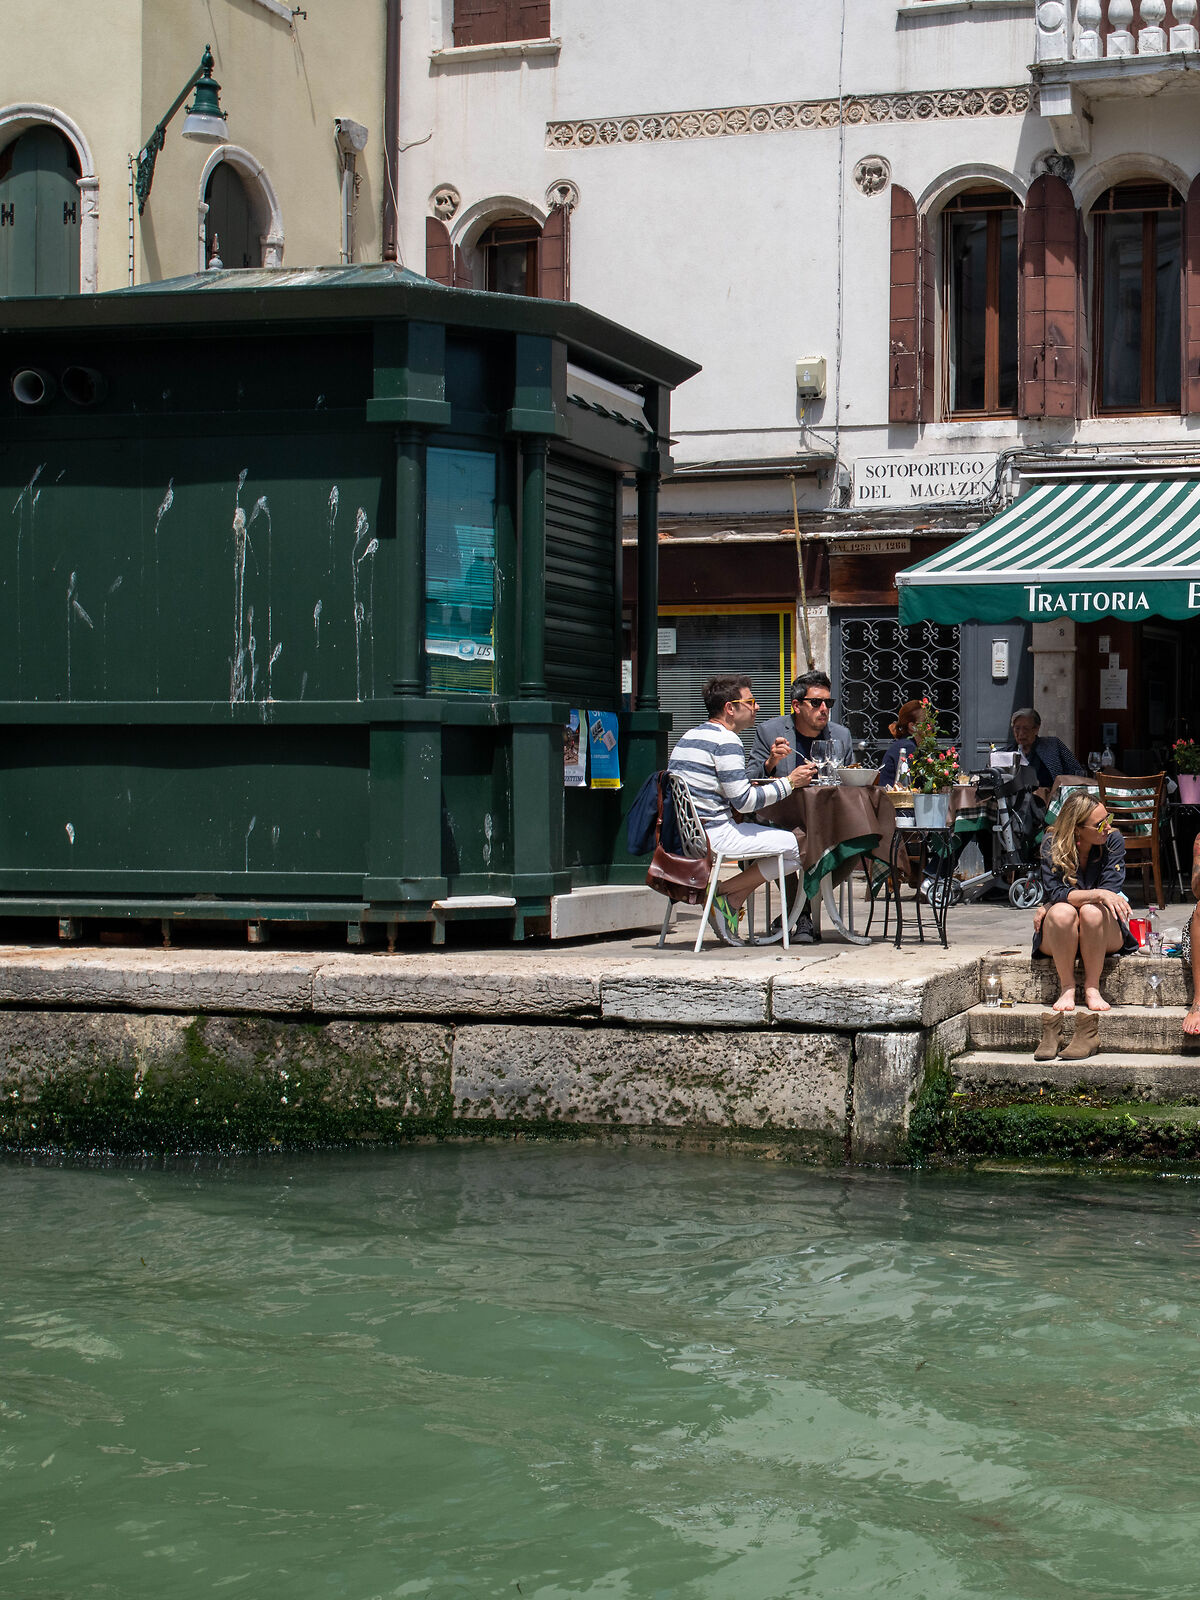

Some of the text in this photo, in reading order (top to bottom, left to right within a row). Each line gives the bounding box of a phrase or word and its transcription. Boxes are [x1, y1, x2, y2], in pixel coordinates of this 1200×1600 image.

[865, 461, 985, 479] SOTOPORTEGO
[859, 481, 993, 499] DEL MAGAZEN
[1024, 584, 1150, 613] TRATTORIA
[476, 646, 492, 657] LIS
